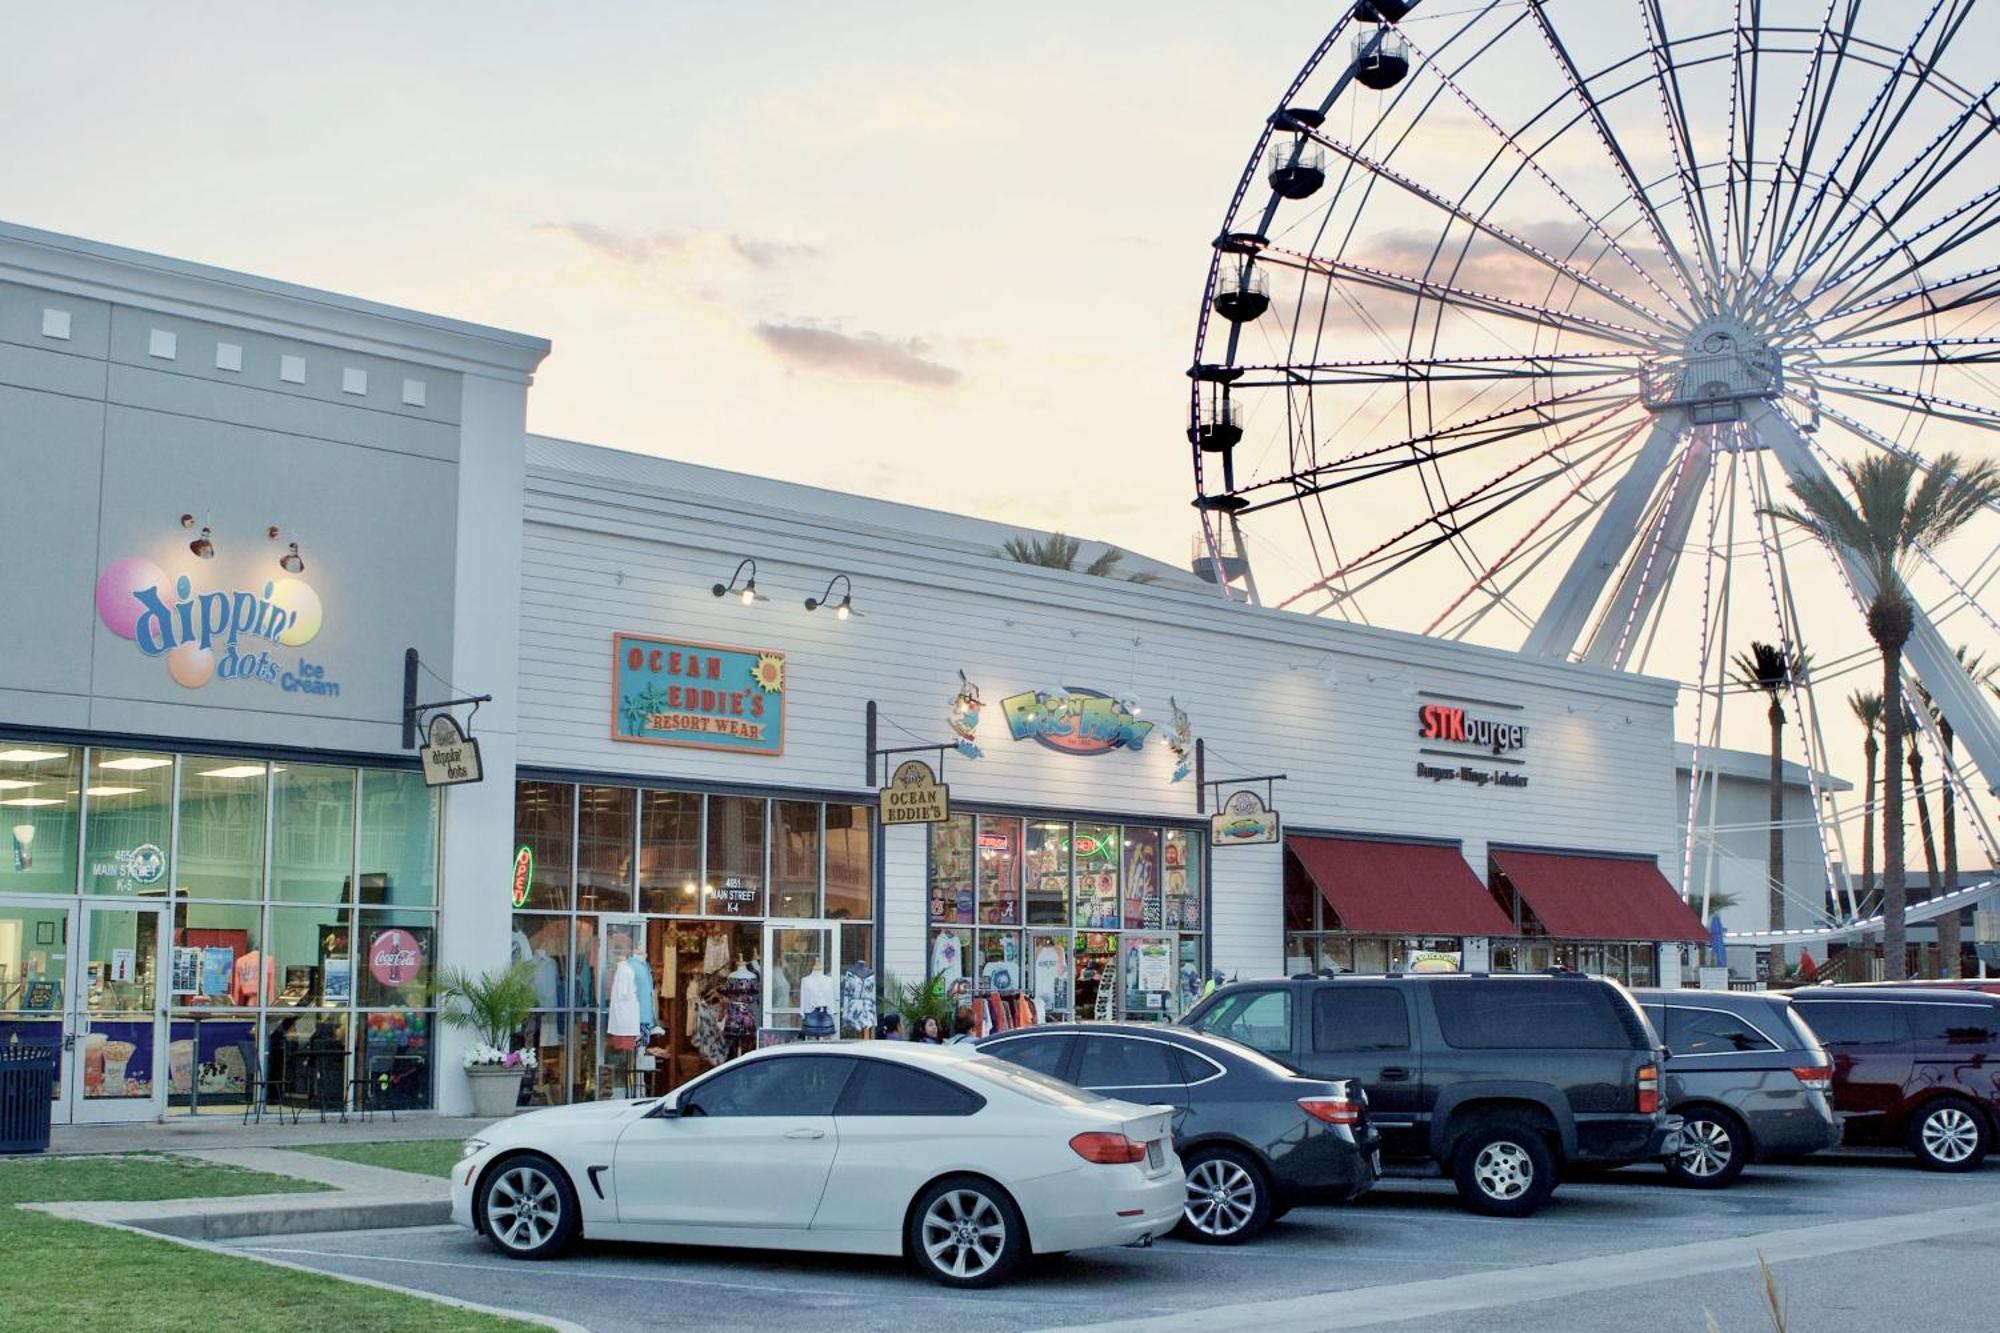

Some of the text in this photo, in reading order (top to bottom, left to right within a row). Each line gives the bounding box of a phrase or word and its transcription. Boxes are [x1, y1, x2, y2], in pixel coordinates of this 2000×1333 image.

[132, 574, 297, 656] dippin'
[217, 646, 281, 680] dots
[299, 657, 324, 679] Ice
[628, 648, 721, 679] OCEAN
[281, 671, 340, 697] Cream
[668, 685, 764, 717] EDDIE'S
[652, 714, 760, 740] RESORT WEAR
[447, 763, 468, 779] dots
[1416, 761, 1456, 782] Burgers
[890, 790, 937, 806] OCEAN
[888, 804, 941, 821] EDDIE'S
[93, 863, 118, 876] MAIN
[514, 851, 529, 902] OPEN
[729, 890, 756, 902] STREET
